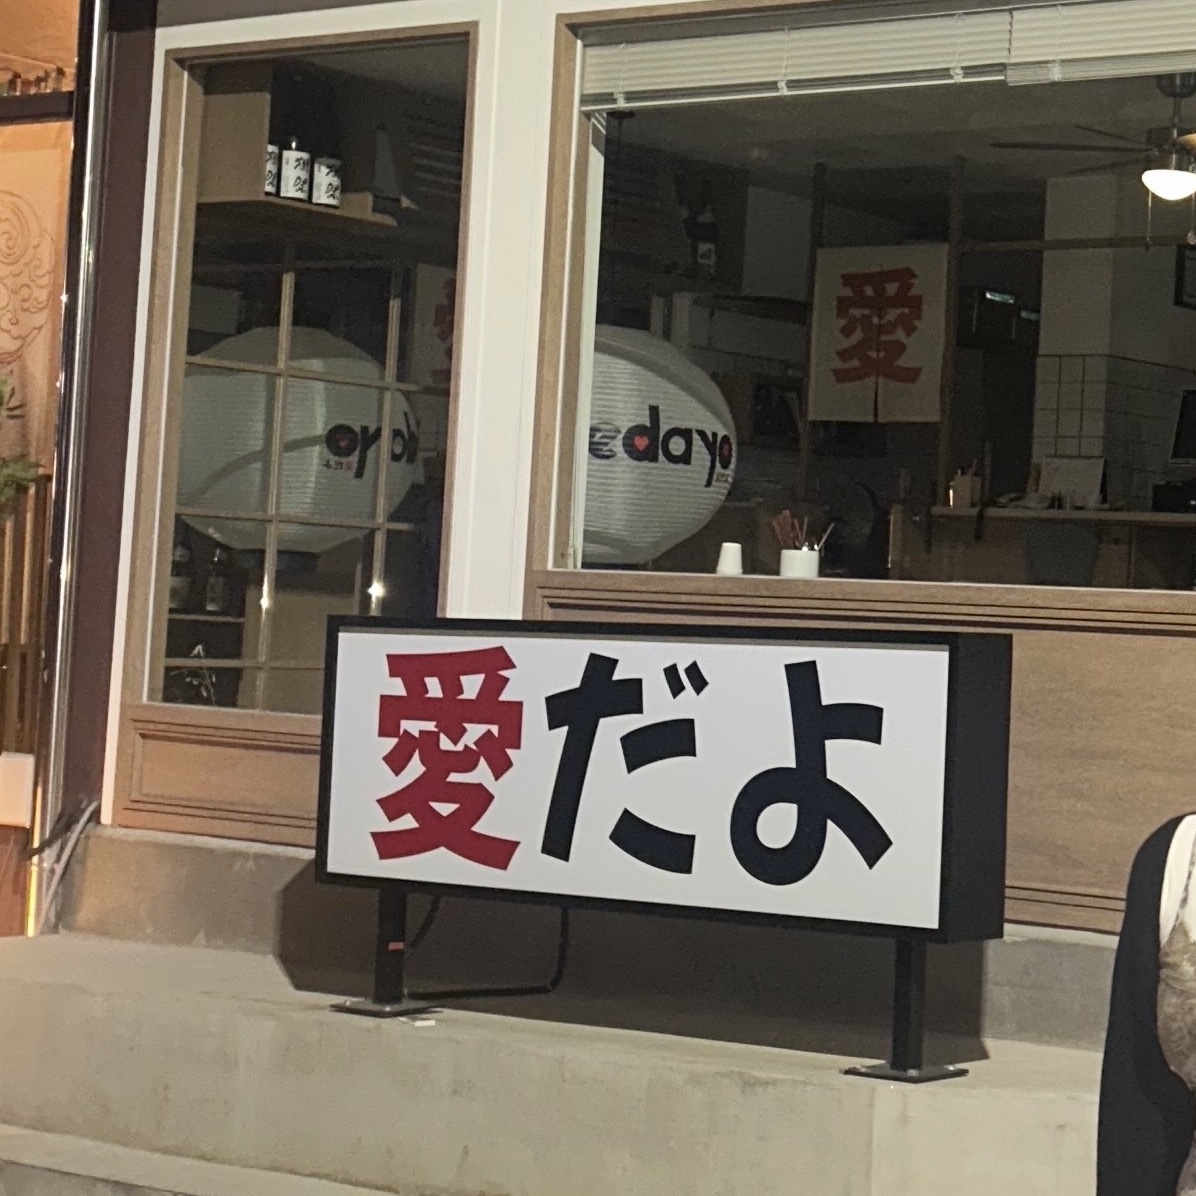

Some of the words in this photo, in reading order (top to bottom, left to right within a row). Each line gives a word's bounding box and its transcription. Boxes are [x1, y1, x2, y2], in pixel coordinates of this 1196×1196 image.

[831, 266, 924, 385] 愛
[369, 644, 893, 886] 愛だよ
